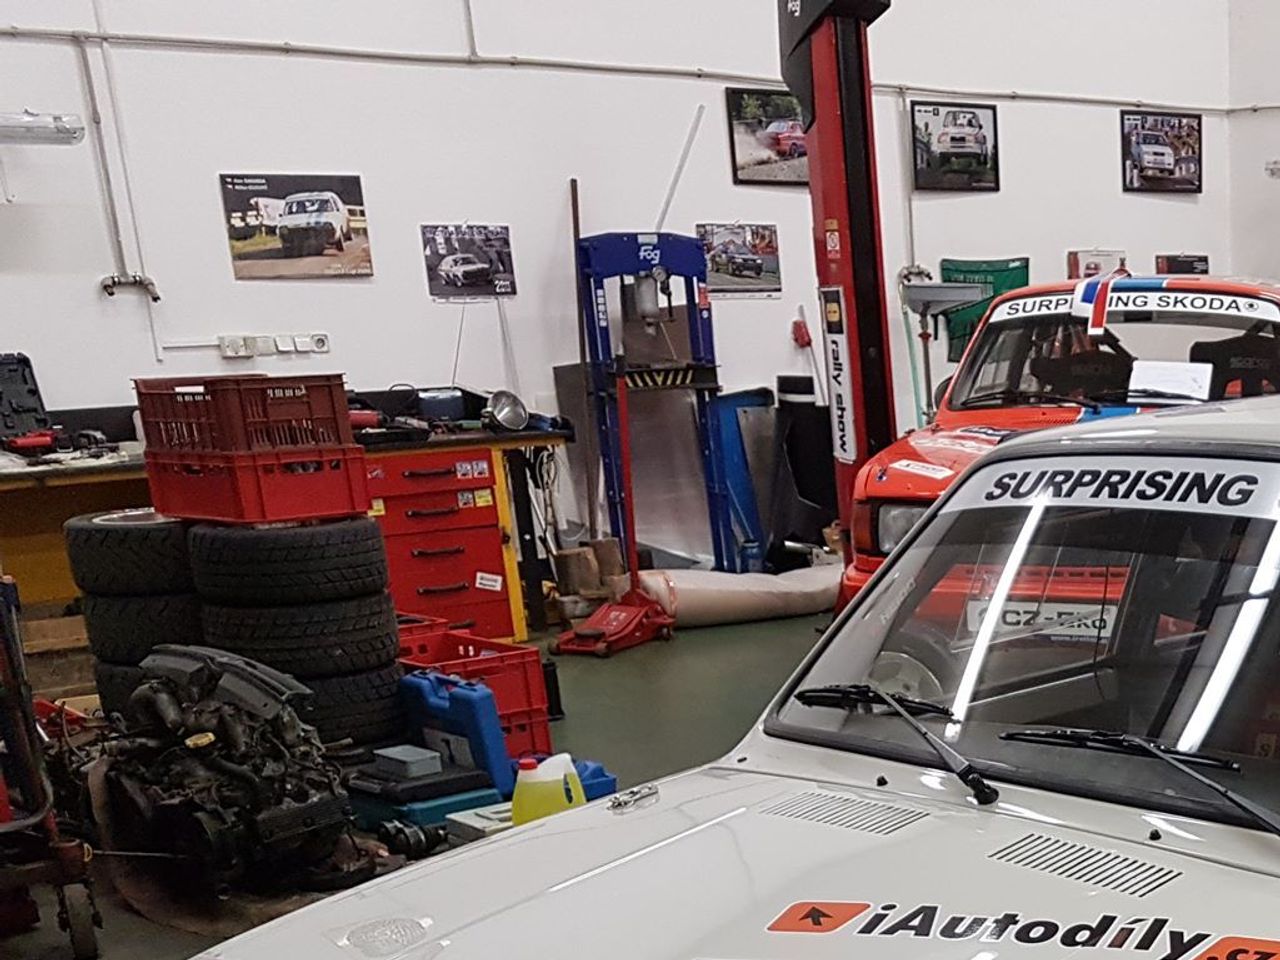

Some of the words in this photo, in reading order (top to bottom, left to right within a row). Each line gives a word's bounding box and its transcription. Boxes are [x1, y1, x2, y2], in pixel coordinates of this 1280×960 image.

[1005, 294, 1149, 316] SURPING
[1156, 294, 1243, 313] SKODA
[830, 339, 843, 387] rally
[834, 393, 848, 453] show
[985, 469, 1259, 507] SURPRISING
